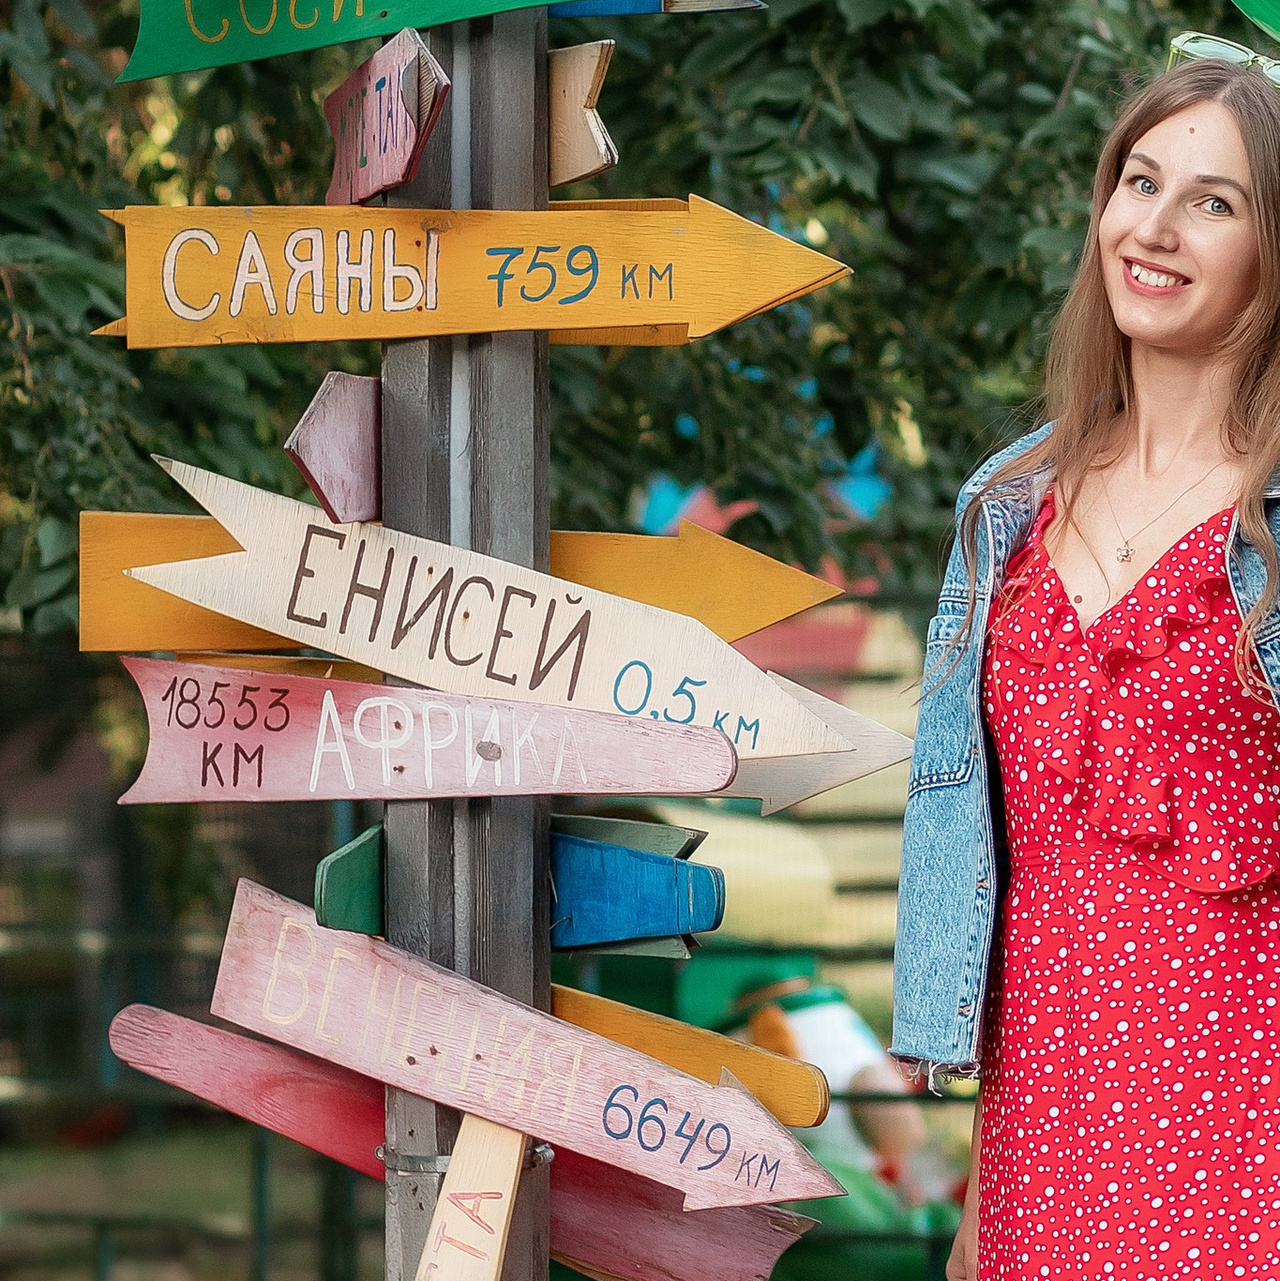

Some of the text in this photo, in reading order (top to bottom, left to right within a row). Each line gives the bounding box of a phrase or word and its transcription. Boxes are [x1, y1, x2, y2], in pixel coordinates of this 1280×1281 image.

[161, 227, 441, 321] САЯНЫ
[486, 244, 600, 308] 759
[286, 524, 591, 701] ЕНИСЕЙ
[160, 675, 589, 793] 18553 АФРИКА
[261, 917, 585, 1125] ВЕНЕЦИЯ
[602, 1084, 732, 1172] 6649
